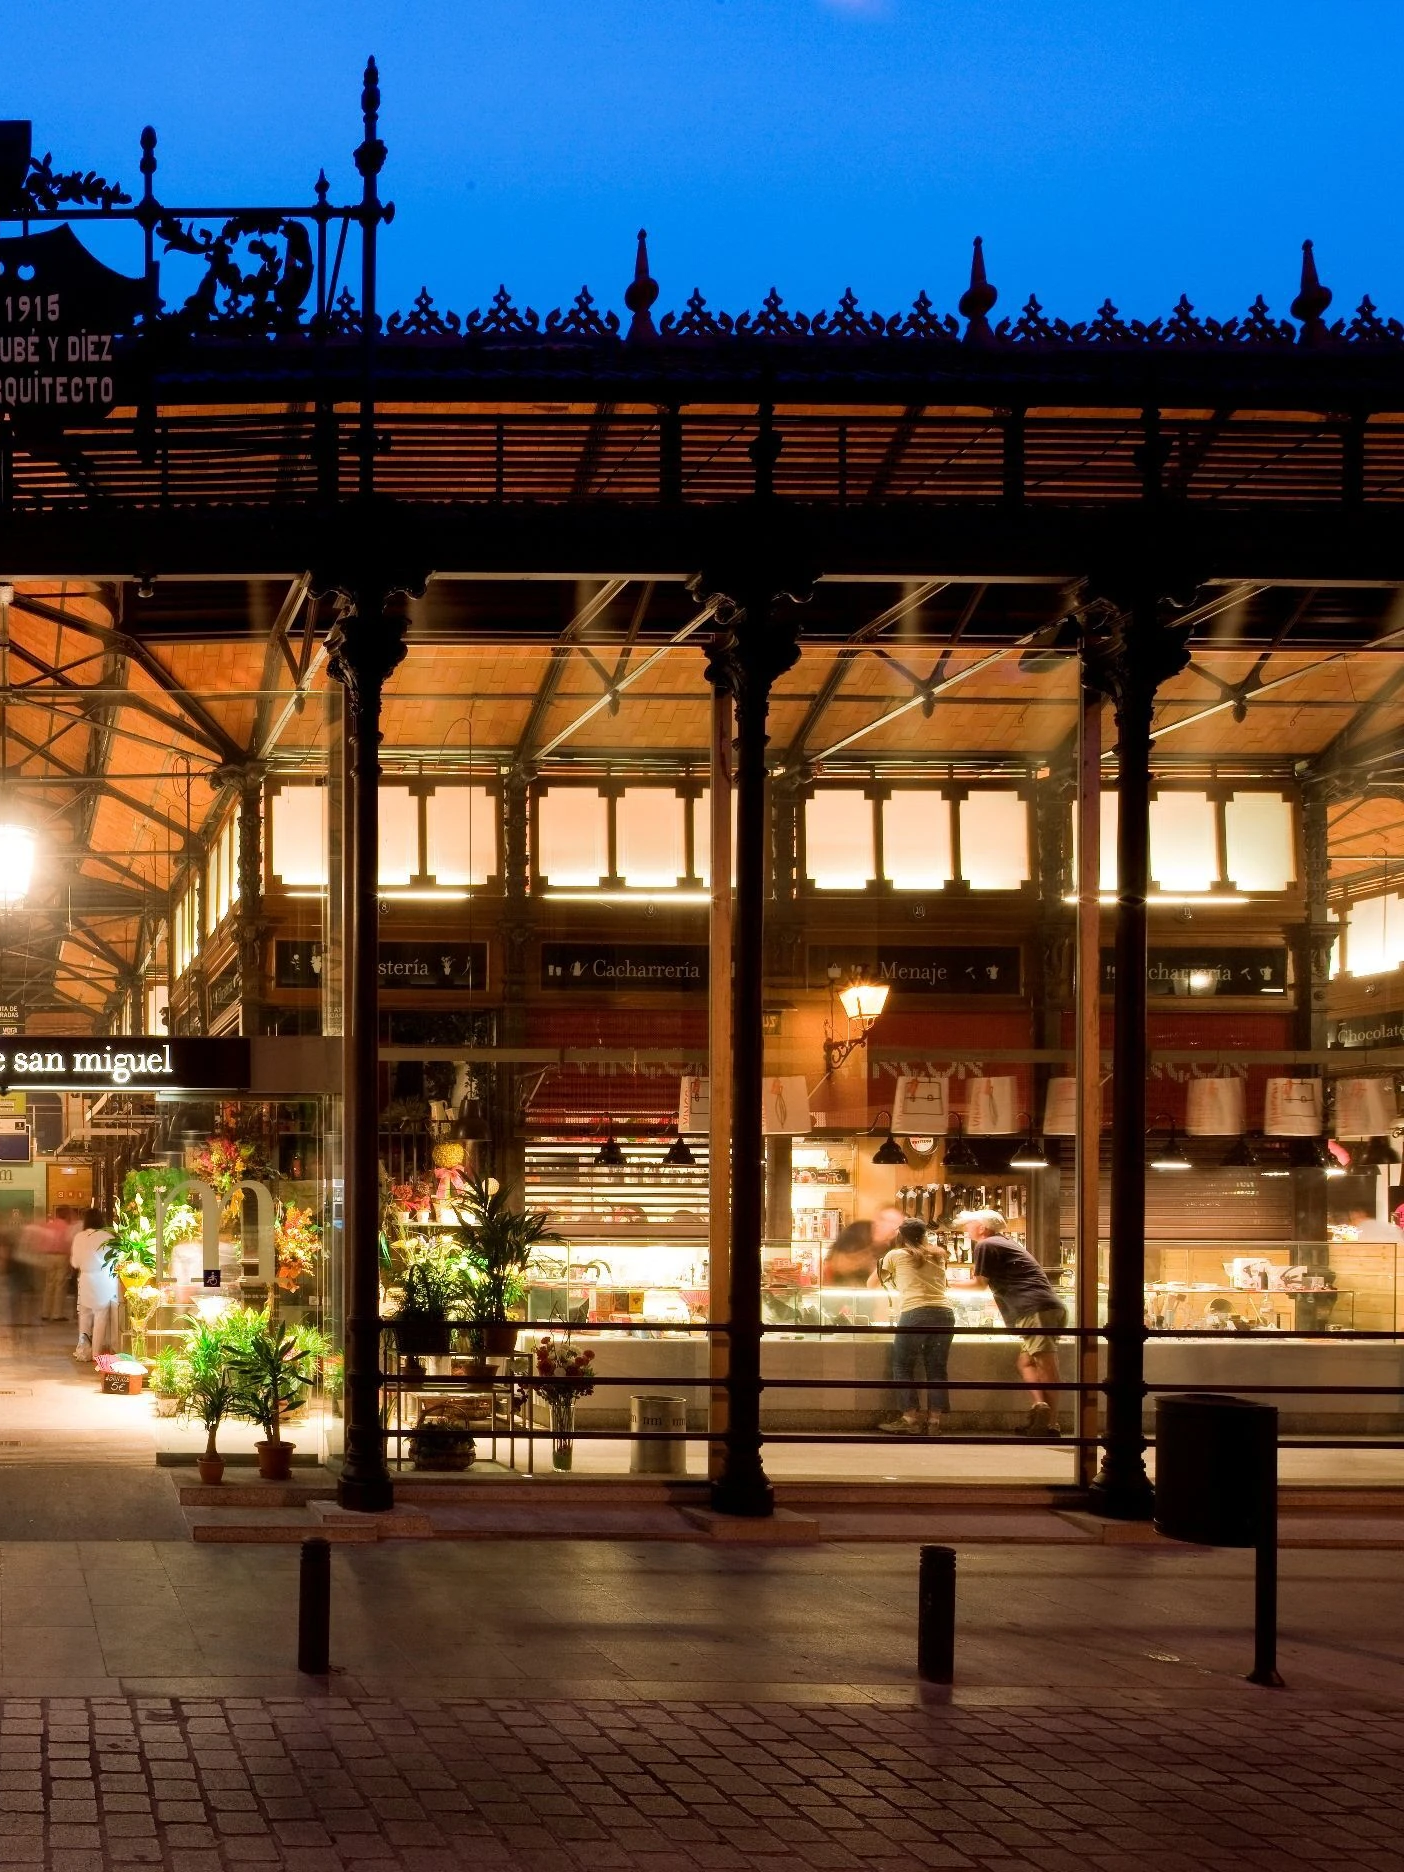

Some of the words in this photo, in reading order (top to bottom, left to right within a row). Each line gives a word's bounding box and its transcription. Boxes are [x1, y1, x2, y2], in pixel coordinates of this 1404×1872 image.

[5, 293, 60, 322] 1915
[48, 336, 59, 363] Y
[378, 958, 429, 976] stería
[592, 958, 701, 979] Cacharrería
[879, 961, 948, 986] Menaje
[1146, 962, 1233, 981] charrería
[13, 1050, 66, 1073] san
[72, 1044, 174, 1084] miguel
[110, 1381, 126, 1392] 5€
